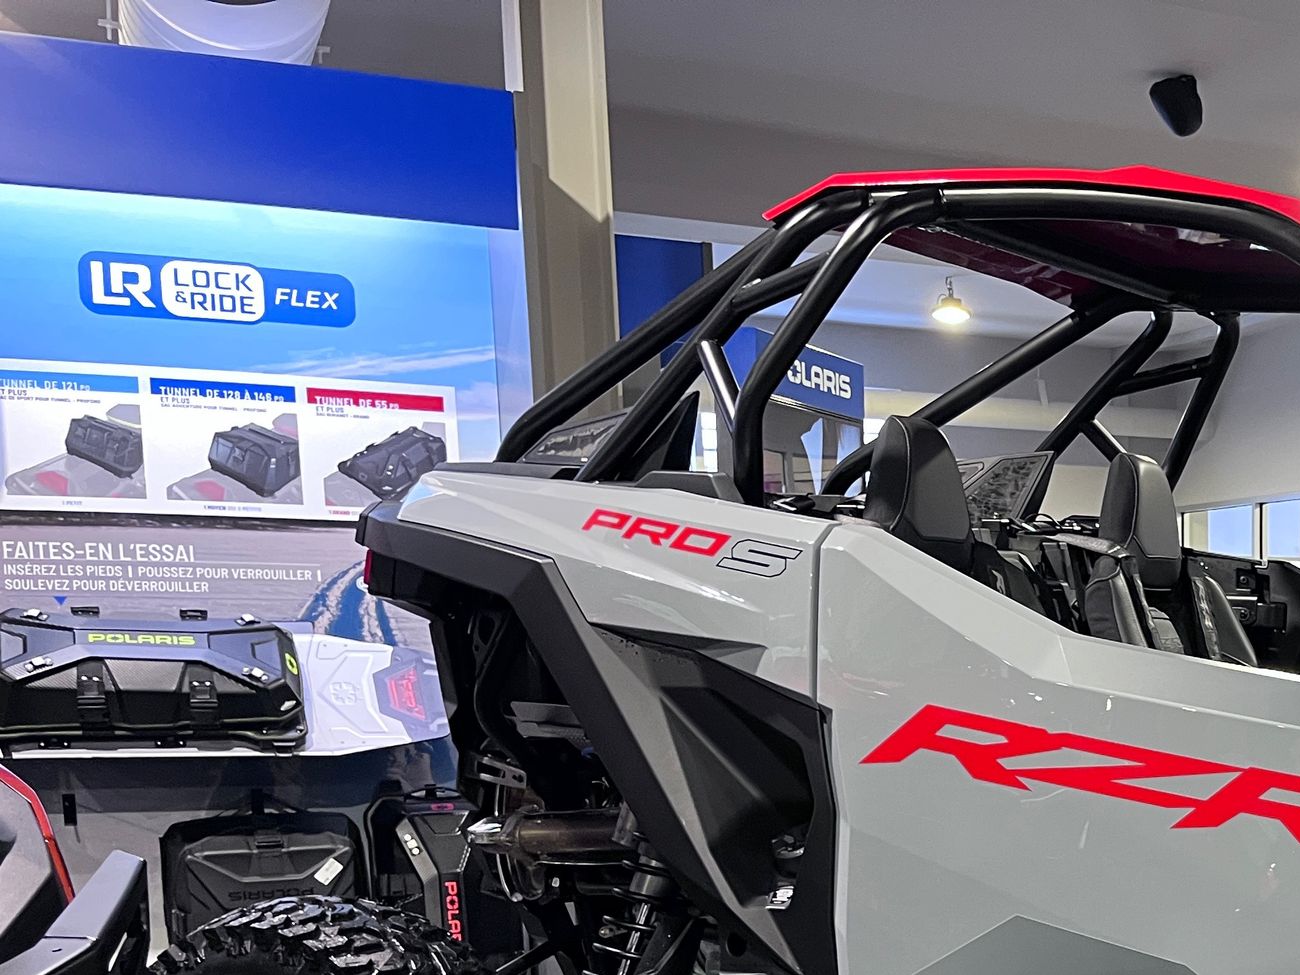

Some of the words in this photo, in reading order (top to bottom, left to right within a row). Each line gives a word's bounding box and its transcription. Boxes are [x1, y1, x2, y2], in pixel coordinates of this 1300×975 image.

[89, 260, 157, 308] LR
[173, 268, 254, 292] LOCK
[175, 291, 257, 315] &RIDE
[275, 288, 340, 310] FLEX
[44, 381, 58, 391] DE
[787, 359, 852, 400] OLARIS
[8, 388, 28, 396] PLUS
[159, 386, 202, 398] TUNNEL
[206, 388, 220, 399] DE
[244, 389, 252, 401] À
[314, 396, 356, 407] TUNNEL
[359, 398, 373, 408] DE
[2, 541, 114, 561] FAITES-EN
[119, 542, 195, 562] L'ESSAI
[582, 508, 733, 558] PRO
[716, 538, 804, 579] S
[3, 562, 57, 576] INSÉREZ
[60, 565, 84, 577] LES
[87, 566, 123, 577] PIEDS
[138, 567, 194, 578] POUSSEZ
[196, 568, 229, 579] POUR
[232, 568, 312, 581] VERROUILLER
[4, 578, 70, 591] SOULEVEZ
[73, 579, 107, 591] POUR
[110, 577, 209, 593] DÉVERROUILLER
[87, 632, 196, 646] POLARIS
[443, 881, 463, 942] POLAR
